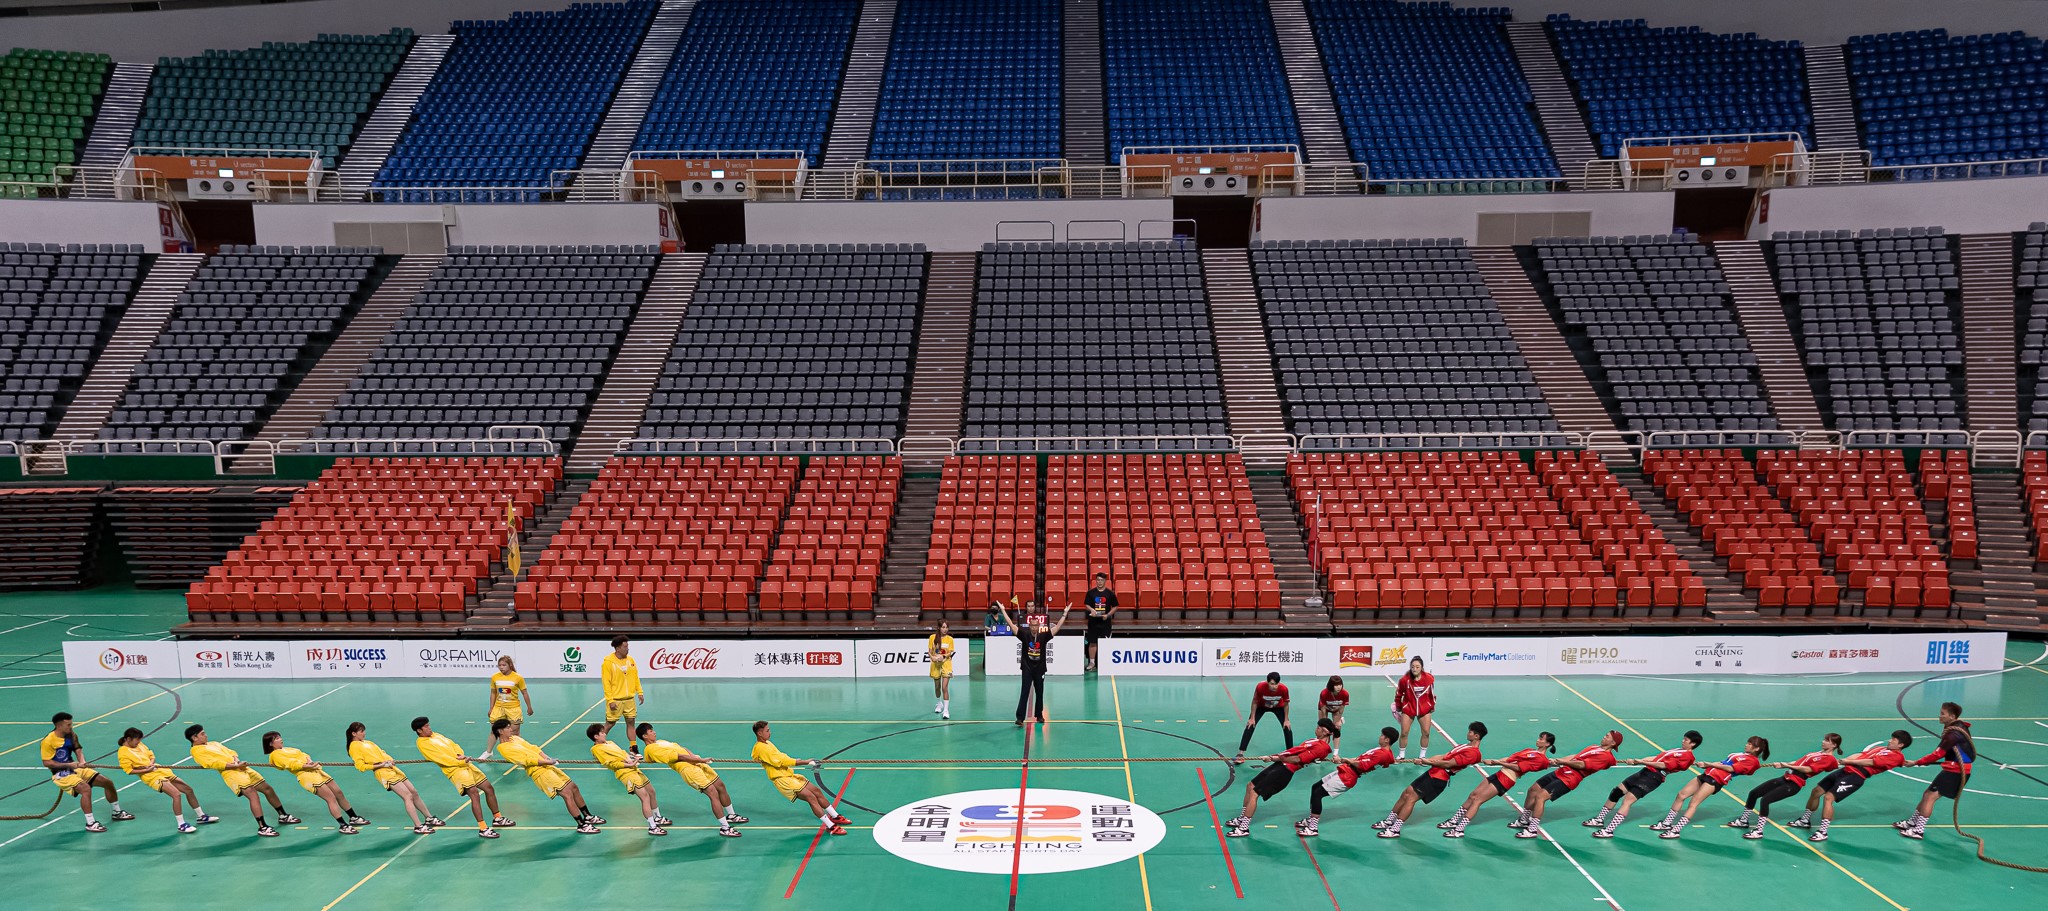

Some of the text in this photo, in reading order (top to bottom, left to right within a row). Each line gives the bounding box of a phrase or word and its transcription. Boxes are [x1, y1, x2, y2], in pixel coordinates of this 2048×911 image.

[232, 651, 275, 661] 新光人壽
[306, 648, 386, 661] 成功 SUCCESS
[884, 652, 919, 663] ONE
[1111, 650, 1198, 664] SAMSUNG
[1462, 653, 1536, 661] FamilyMart Collection
[1695, 649, 1744, 658] CHARMING
[1799, 650, 1824, 659] Castrol
[1926, 640, 1970, 665] 肌樂
[809, 653, 840, 664] 打卡錠
